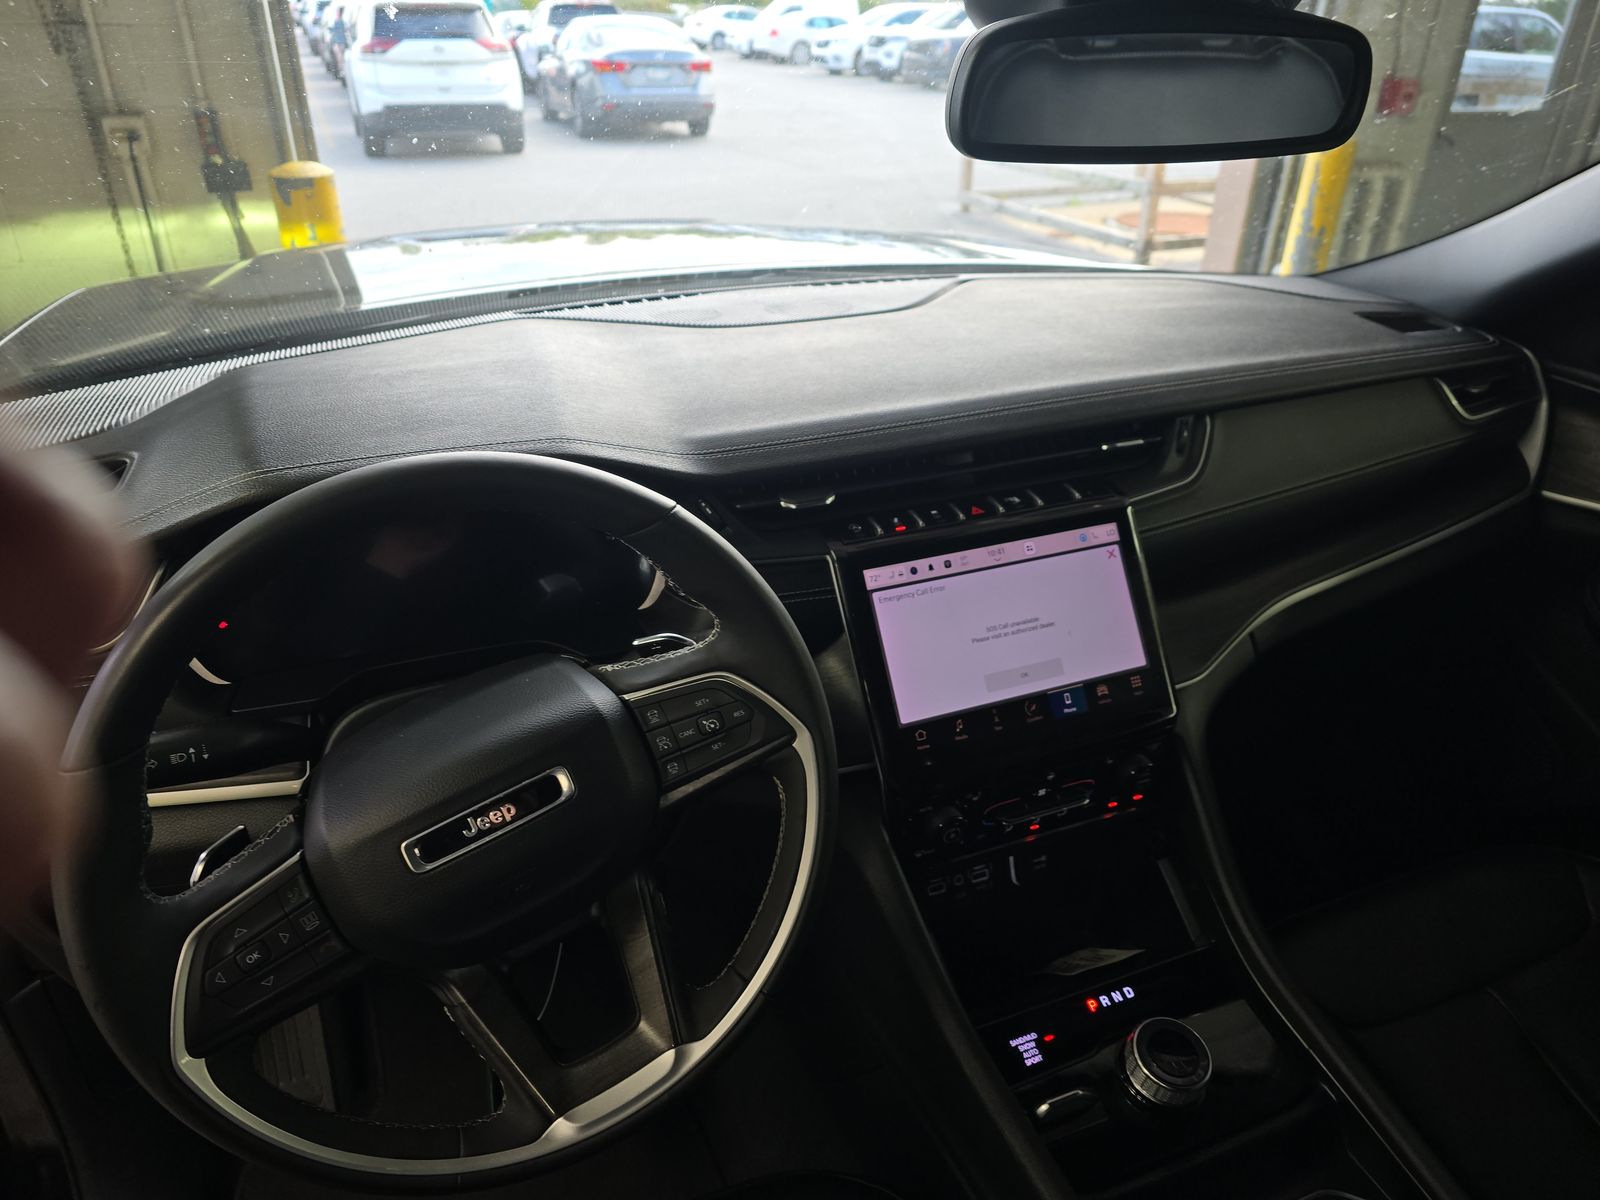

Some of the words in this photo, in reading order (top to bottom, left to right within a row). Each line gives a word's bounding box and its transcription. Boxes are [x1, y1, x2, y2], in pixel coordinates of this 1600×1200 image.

[878, 590, 915, 604] Emergency
[916, 587, 929, 597] Call
[929, 584, 946, 595] Error
[998, 622, 1009, 630] Call
[971, 636, 990, 644] Please
[1011, 625, 1039, 636] authorized
[678, 728, 696, 738] CANC
[462, 802, 517, 838] Jeep
[245, 950, 262, 964] OK
[1018, 1040, 1036, 1052] SNOW
[1022, 1048, 1039, 1059] AUTO
[1024, 1054, 1043, 1067] SPORT
